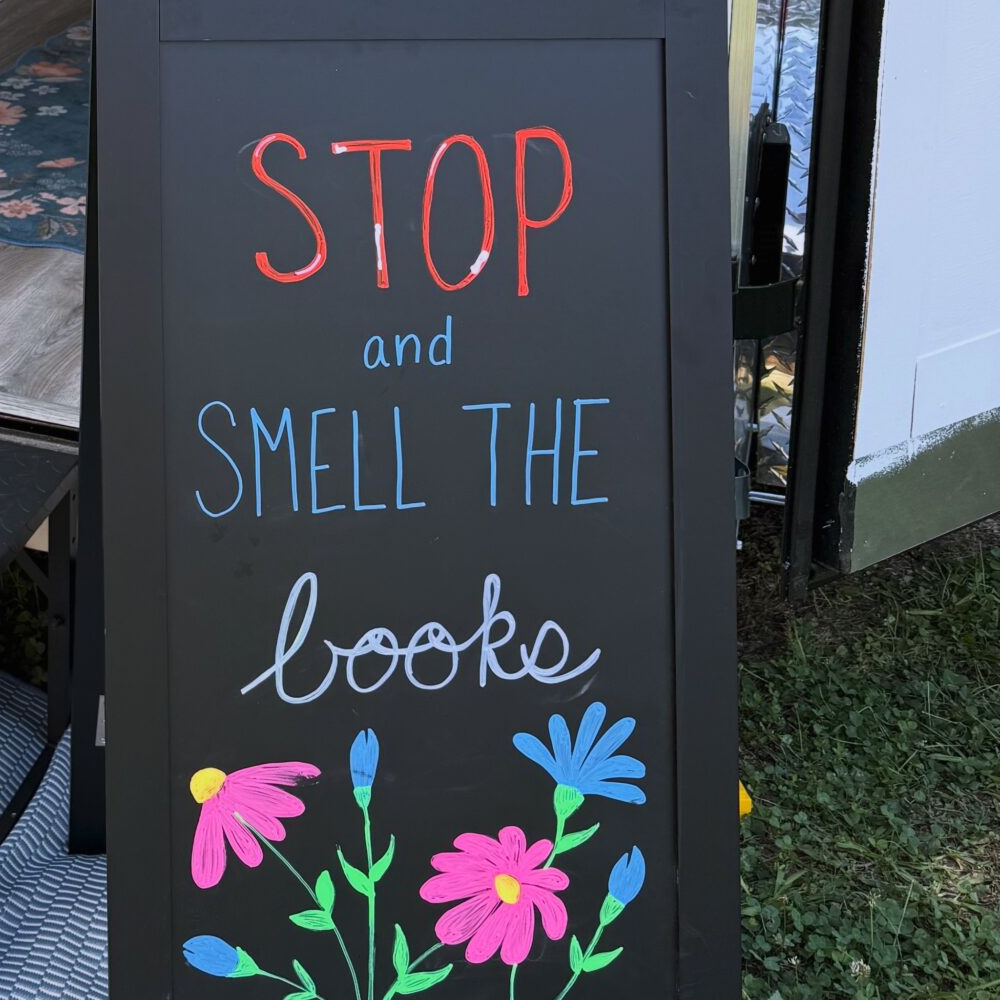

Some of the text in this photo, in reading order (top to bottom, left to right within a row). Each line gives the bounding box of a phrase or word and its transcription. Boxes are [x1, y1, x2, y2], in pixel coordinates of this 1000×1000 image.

[251, 126, 573, 297] STOP
[363, 315, 453, 369] and
[195, 398, 609, 517] SMELL THE
[240, 571, 601, 704] books
